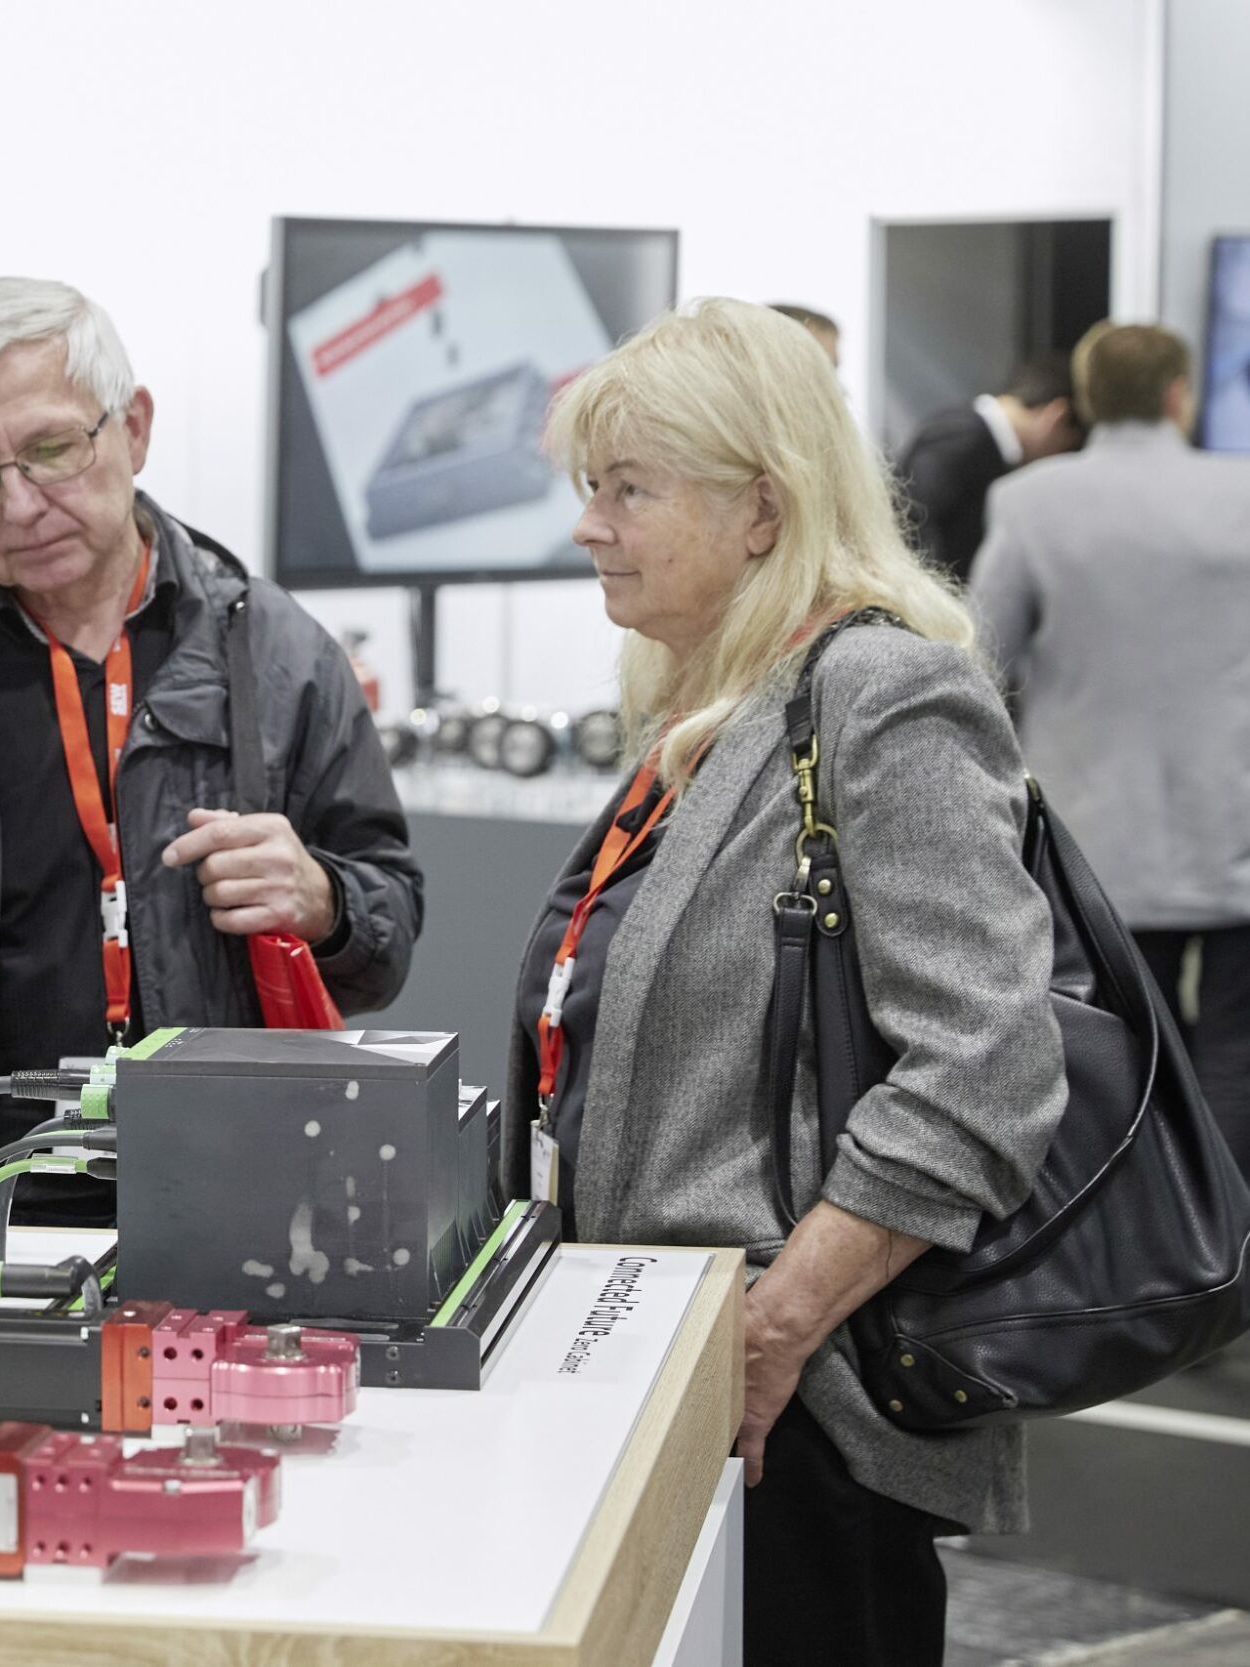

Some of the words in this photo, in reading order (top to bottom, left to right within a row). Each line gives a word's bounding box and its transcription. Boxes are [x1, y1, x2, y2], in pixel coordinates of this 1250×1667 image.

[596, 1256, 658, 1303] Connected
[578, 1304, 633, 1336] Future
[571, 1338, 598, 1351] Zero
[558, 1352, 590, 1374] Cabinet
